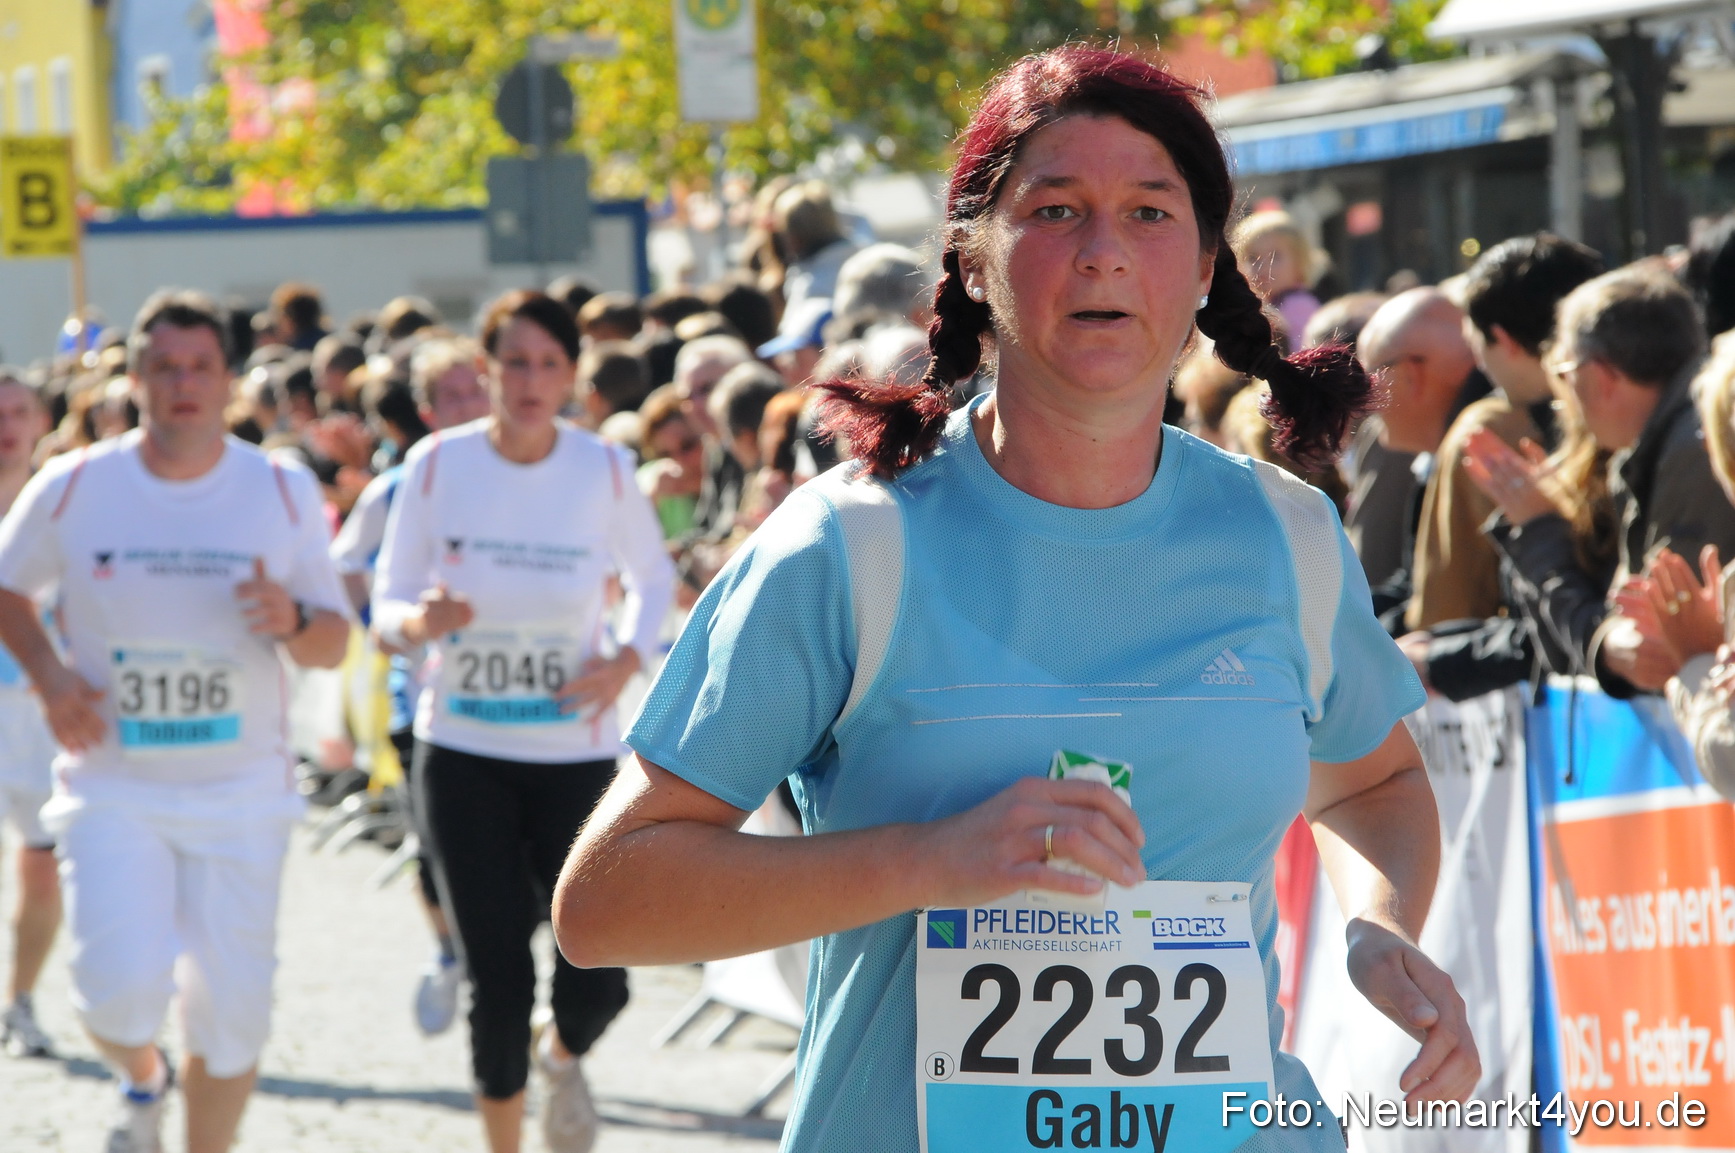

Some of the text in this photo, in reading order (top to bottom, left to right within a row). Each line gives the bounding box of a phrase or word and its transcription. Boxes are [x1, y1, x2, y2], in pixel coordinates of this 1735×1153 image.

[19, 171, 57, 230] B
[457, 651, 567, 694] 2046
[1200, 671, 1255, 687] adidas
[120, 671, 229, 714] 3196
[139, 719, 214, 744] Tobias
[973, 909, 1121, 935] PFLEIDERER
[1152, 917, 1226, 936] BOCK
[1607, 892, 1656, 953] aus
[973, 938, 1122, 953] AKTIENGESELLSCHAFT
[959, 962, 1231, 1077] 2232
[934, 1057, 945, 1077] B
[1026, 1089, 1175, 1153] Gaby
